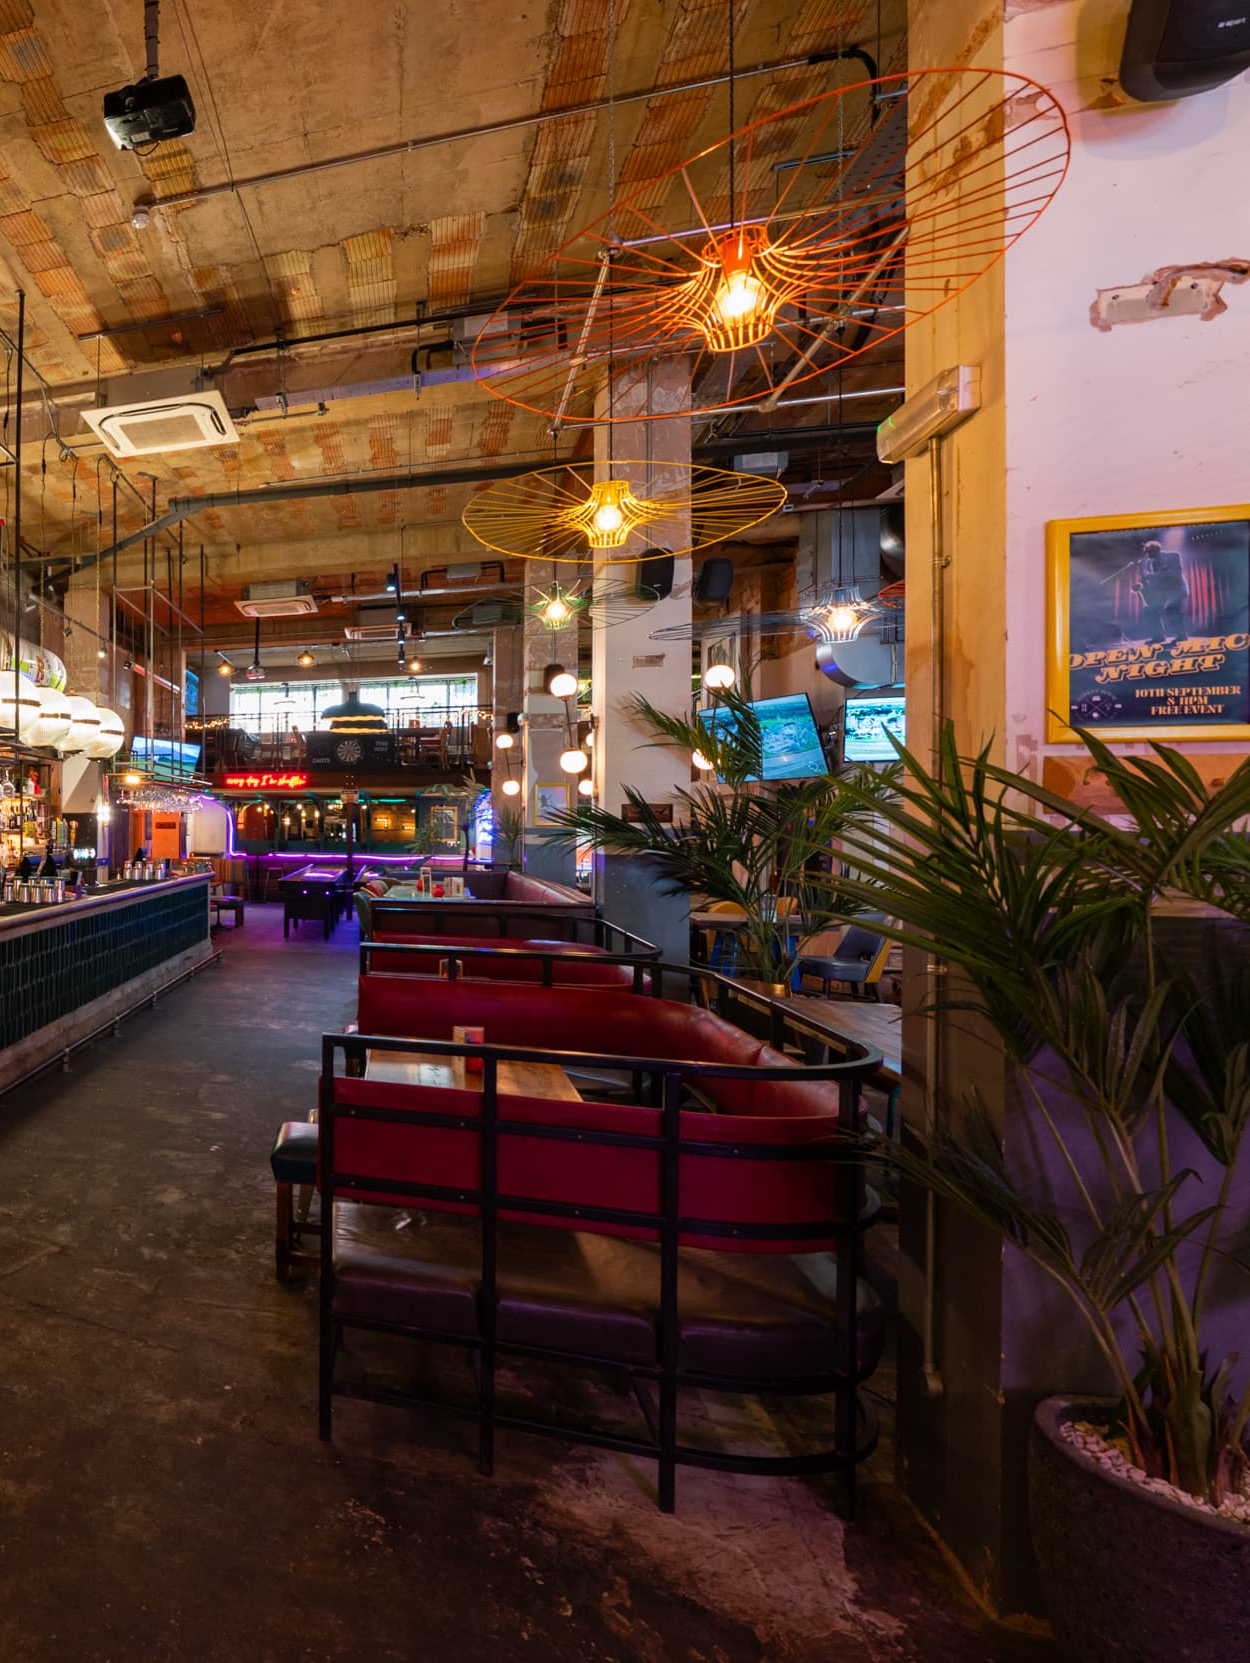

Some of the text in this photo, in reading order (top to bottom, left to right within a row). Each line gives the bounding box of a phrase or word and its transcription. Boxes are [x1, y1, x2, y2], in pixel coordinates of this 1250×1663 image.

[1070, 633, 1250, 670] OPEN MIC
[1095, 654, 1225, 684] NIGHT
[1135, 685, 1241, 698] 10TH SEPTEMBER
[1150, 704, 1223, 715] FREE EVENT
